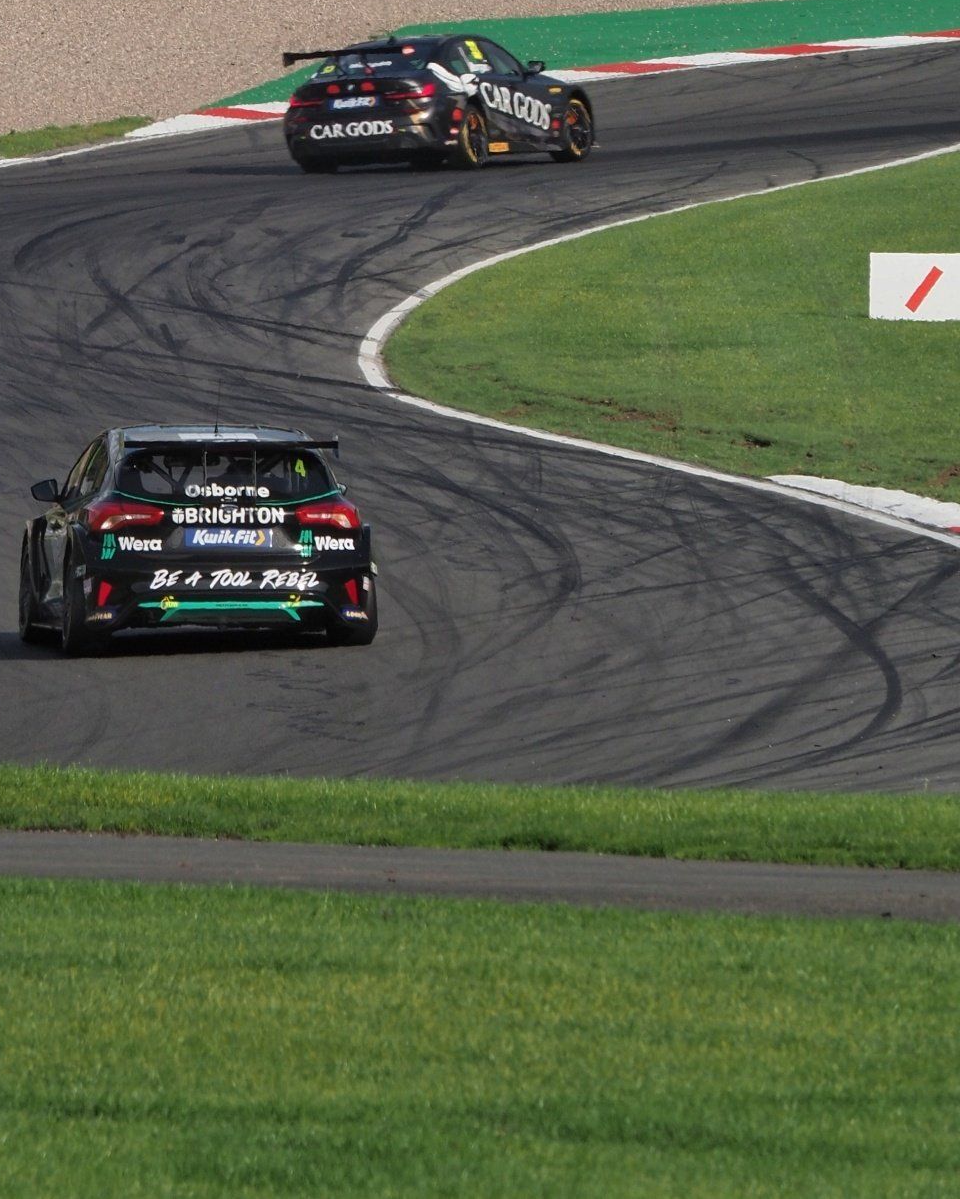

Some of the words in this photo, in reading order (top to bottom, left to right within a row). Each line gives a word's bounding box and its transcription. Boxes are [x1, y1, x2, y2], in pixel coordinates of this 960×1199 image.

[479, 82, 513, 115] CAR
[513, 92, 552, 130] GODS
[310, 123, 346, 140] CAR
[345, 120, 394, 137] GODS
[294, 459, 306, 478] 4
[185, 483, 270, 498] Osborne
[185, 507, 285, 524] BRIGHTON
[117, 536, 163, 552] Wera
[314, 535, 356, 552] Wera
[149, 569, 184, 590] BE
[184, 571, 203, 588] A
[209, 569, 253, 590] TOOL
[259, 569, 320, 591] REBEL
